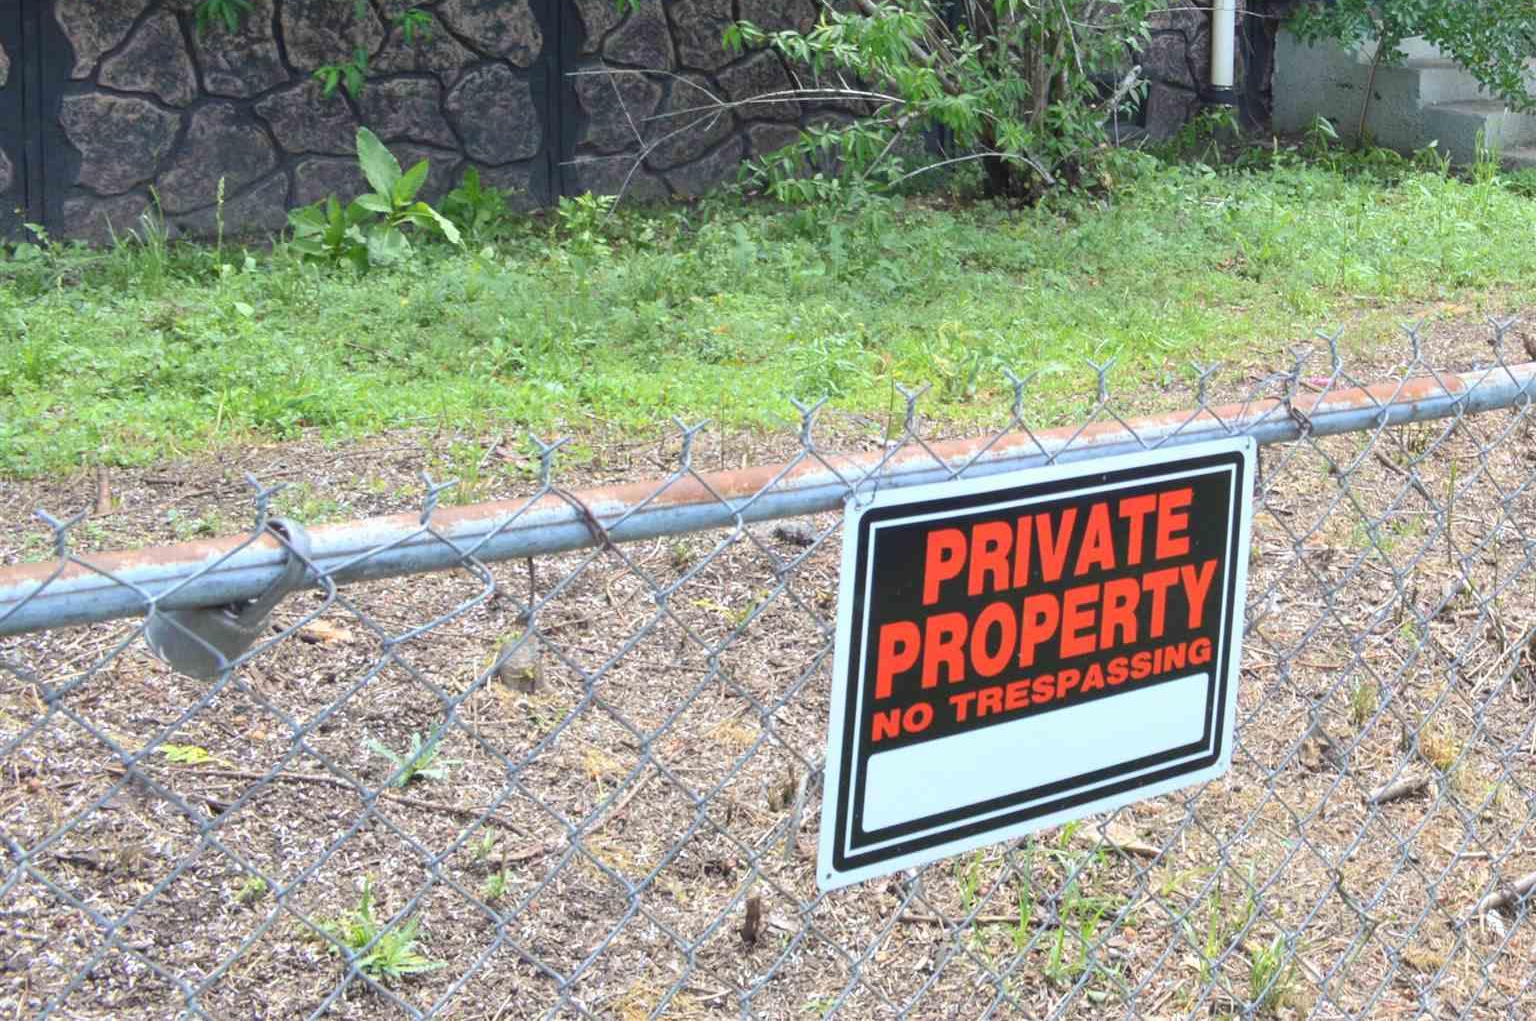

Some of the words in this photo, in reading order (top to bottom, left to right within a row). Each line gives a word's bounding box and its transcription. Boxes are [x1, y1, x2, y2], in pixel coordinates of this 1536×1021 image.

[922, 487, 1194, 606] PRIVATE
[871, 702, 934, 741] NO
[949, 637, 1213, 722] TRESPASSING
[875, 559, 1218, 700] PROPERTY
